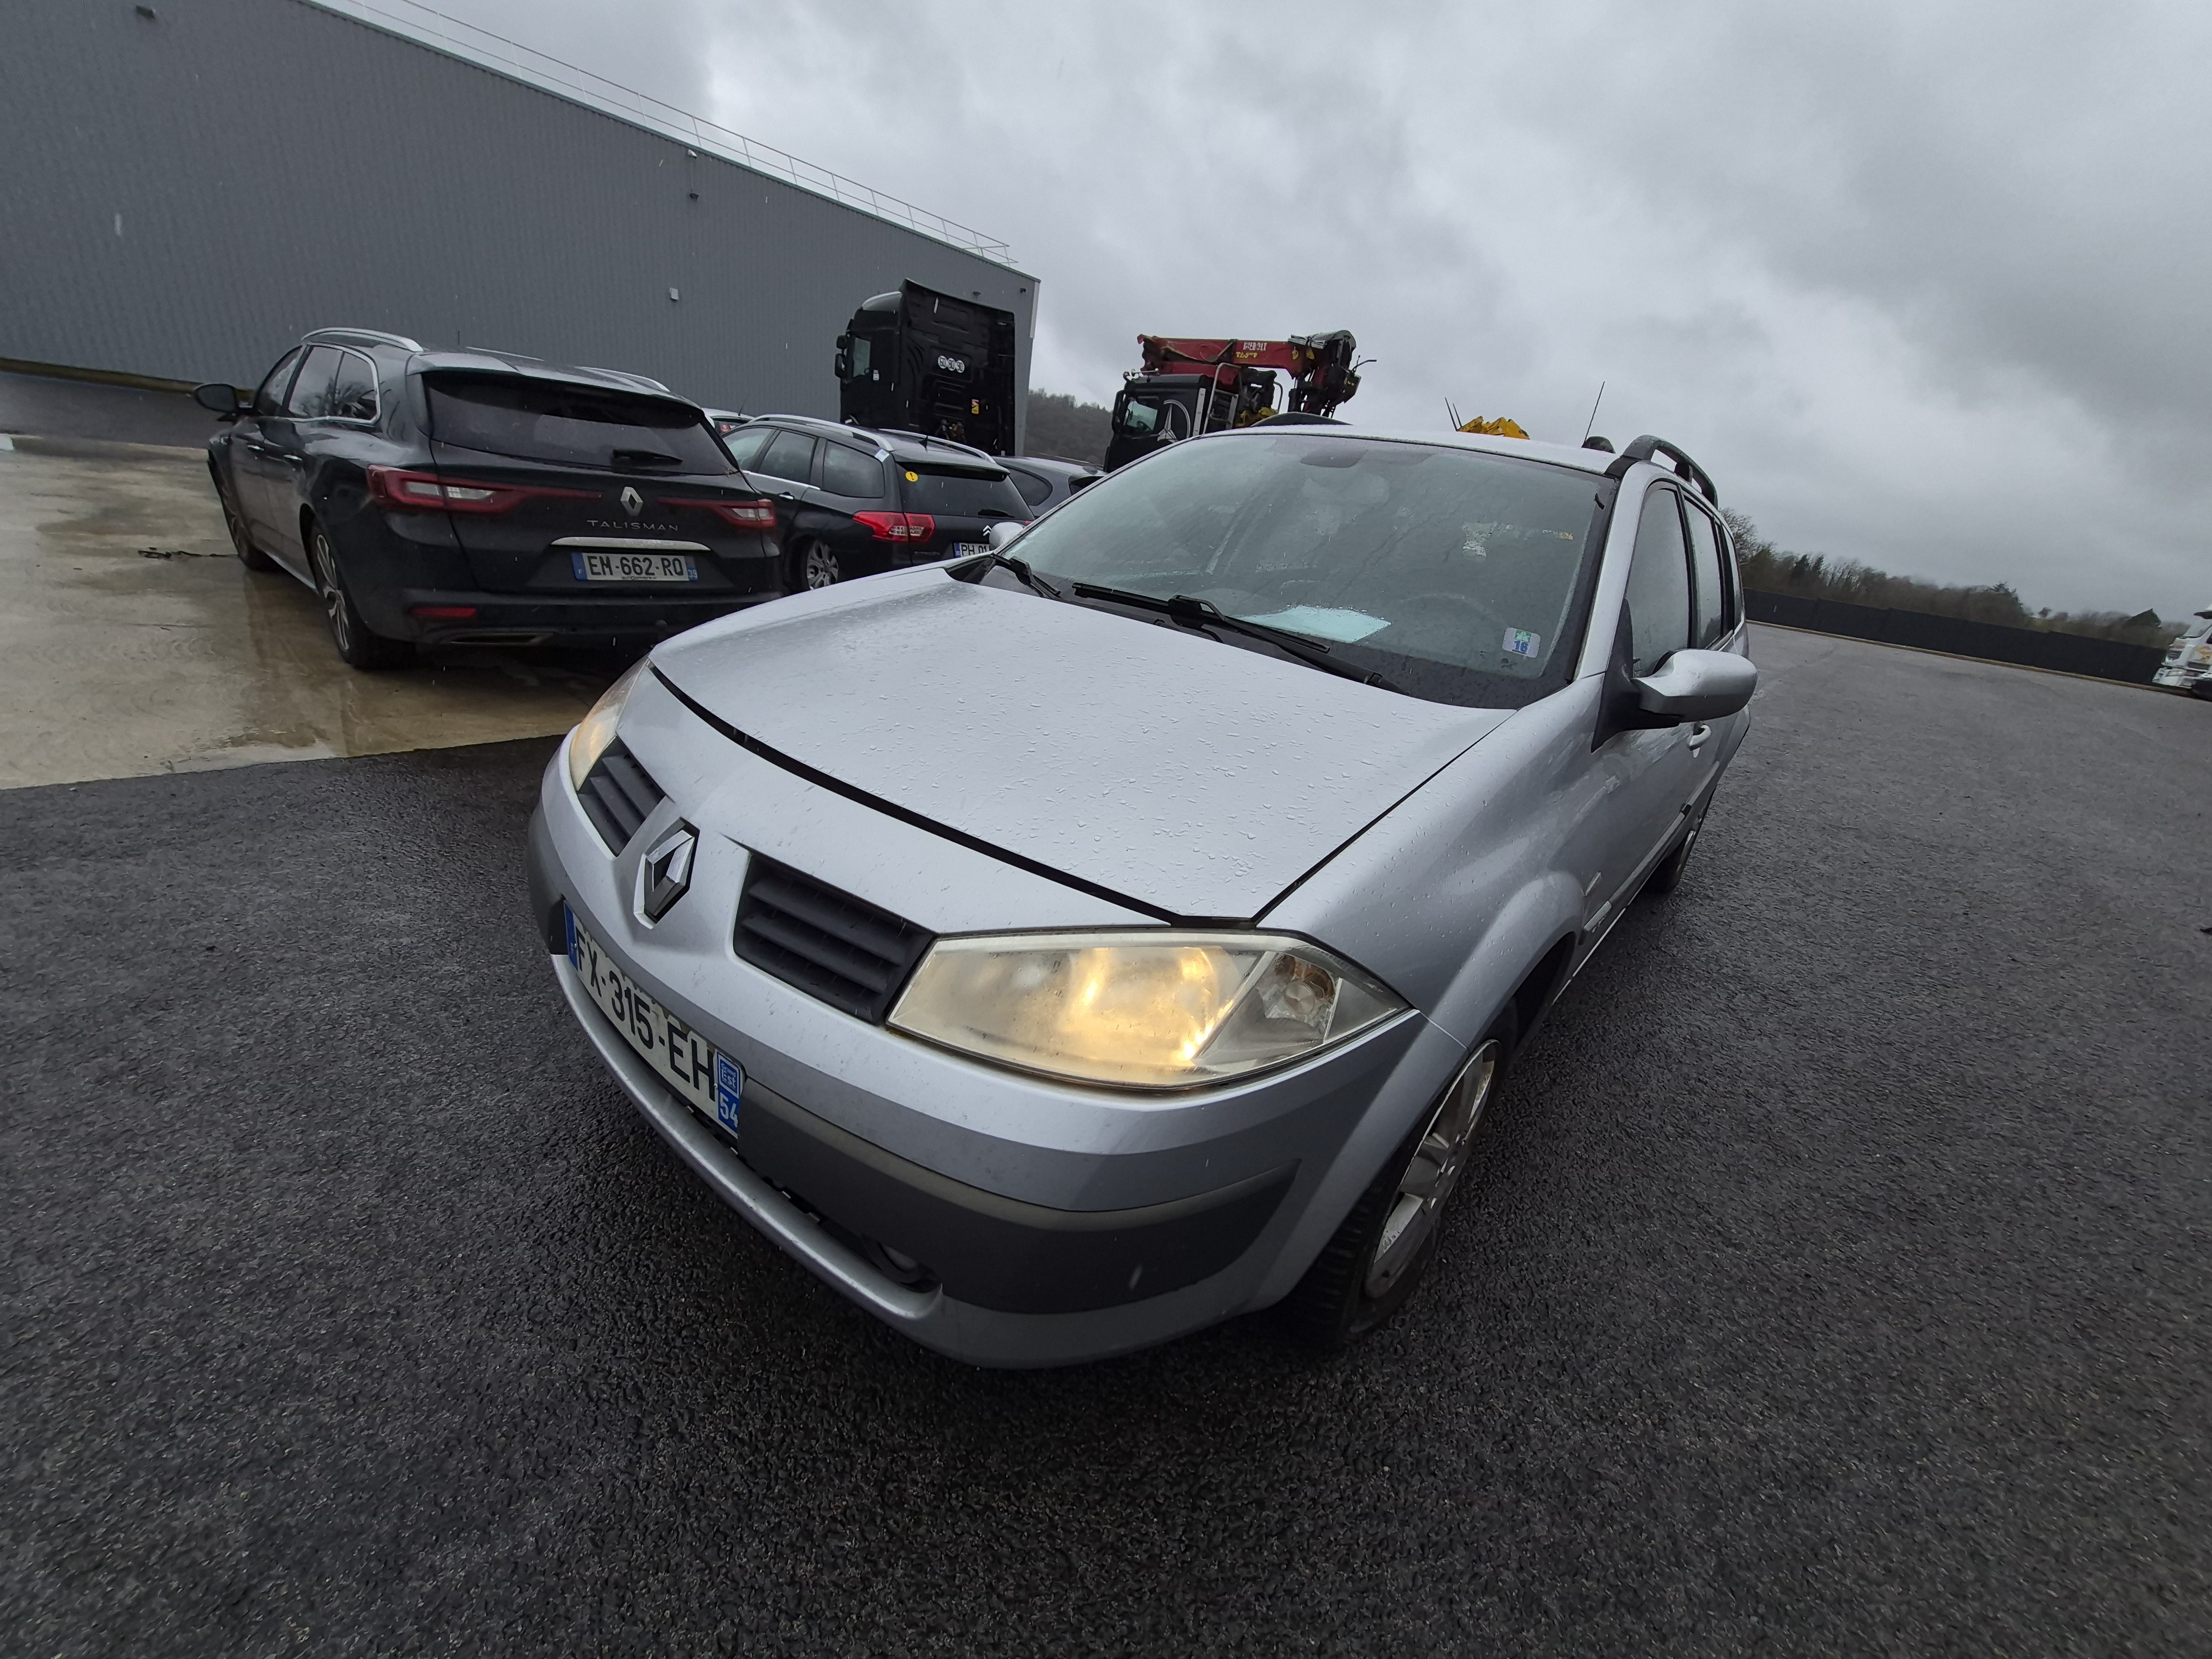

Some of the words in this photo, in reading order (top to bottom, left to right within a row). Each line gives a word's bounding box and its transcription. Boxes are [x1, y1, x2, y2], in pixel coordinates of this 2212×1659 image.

[940, 357, 946, 367] 60
[948, 359, 955, 369] 80
[587, 520, 679, 531] TALISMAN
[961, 544, 975, 556] PH
[1514, 640, 1529, 652] 16
[575, 926, 716, 1102] FX-315-EH
[719, 1092, 739, 1128] 54
